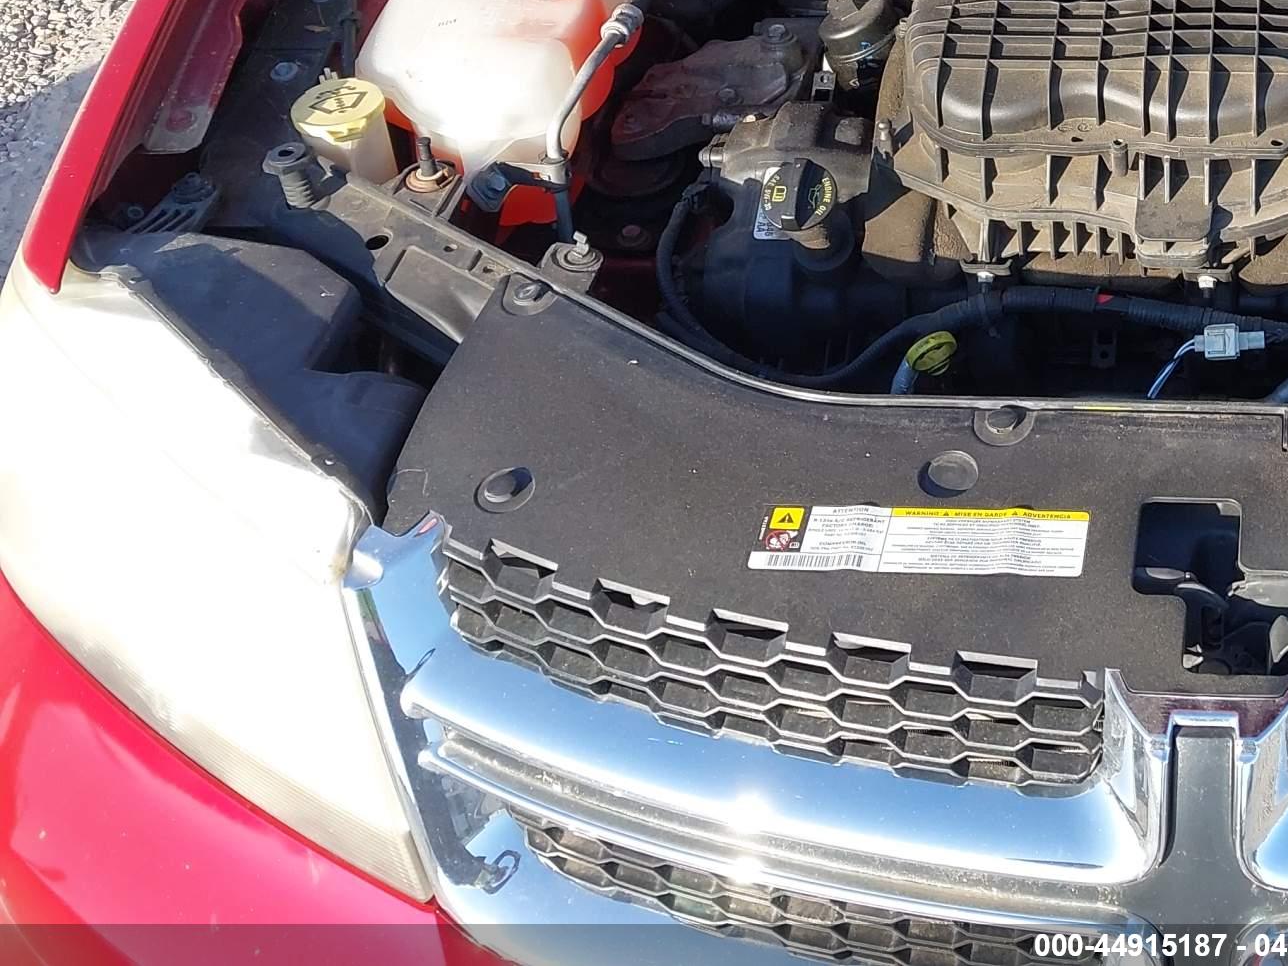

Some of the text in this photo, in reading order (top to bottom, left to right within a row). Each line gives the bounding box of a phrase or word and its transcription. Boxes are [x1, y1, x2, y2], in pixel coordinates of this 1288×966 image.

[815, 177, 833, 216] ENGINE OIL
[1022, 511, 1071, 519] ADVERTENCIA
